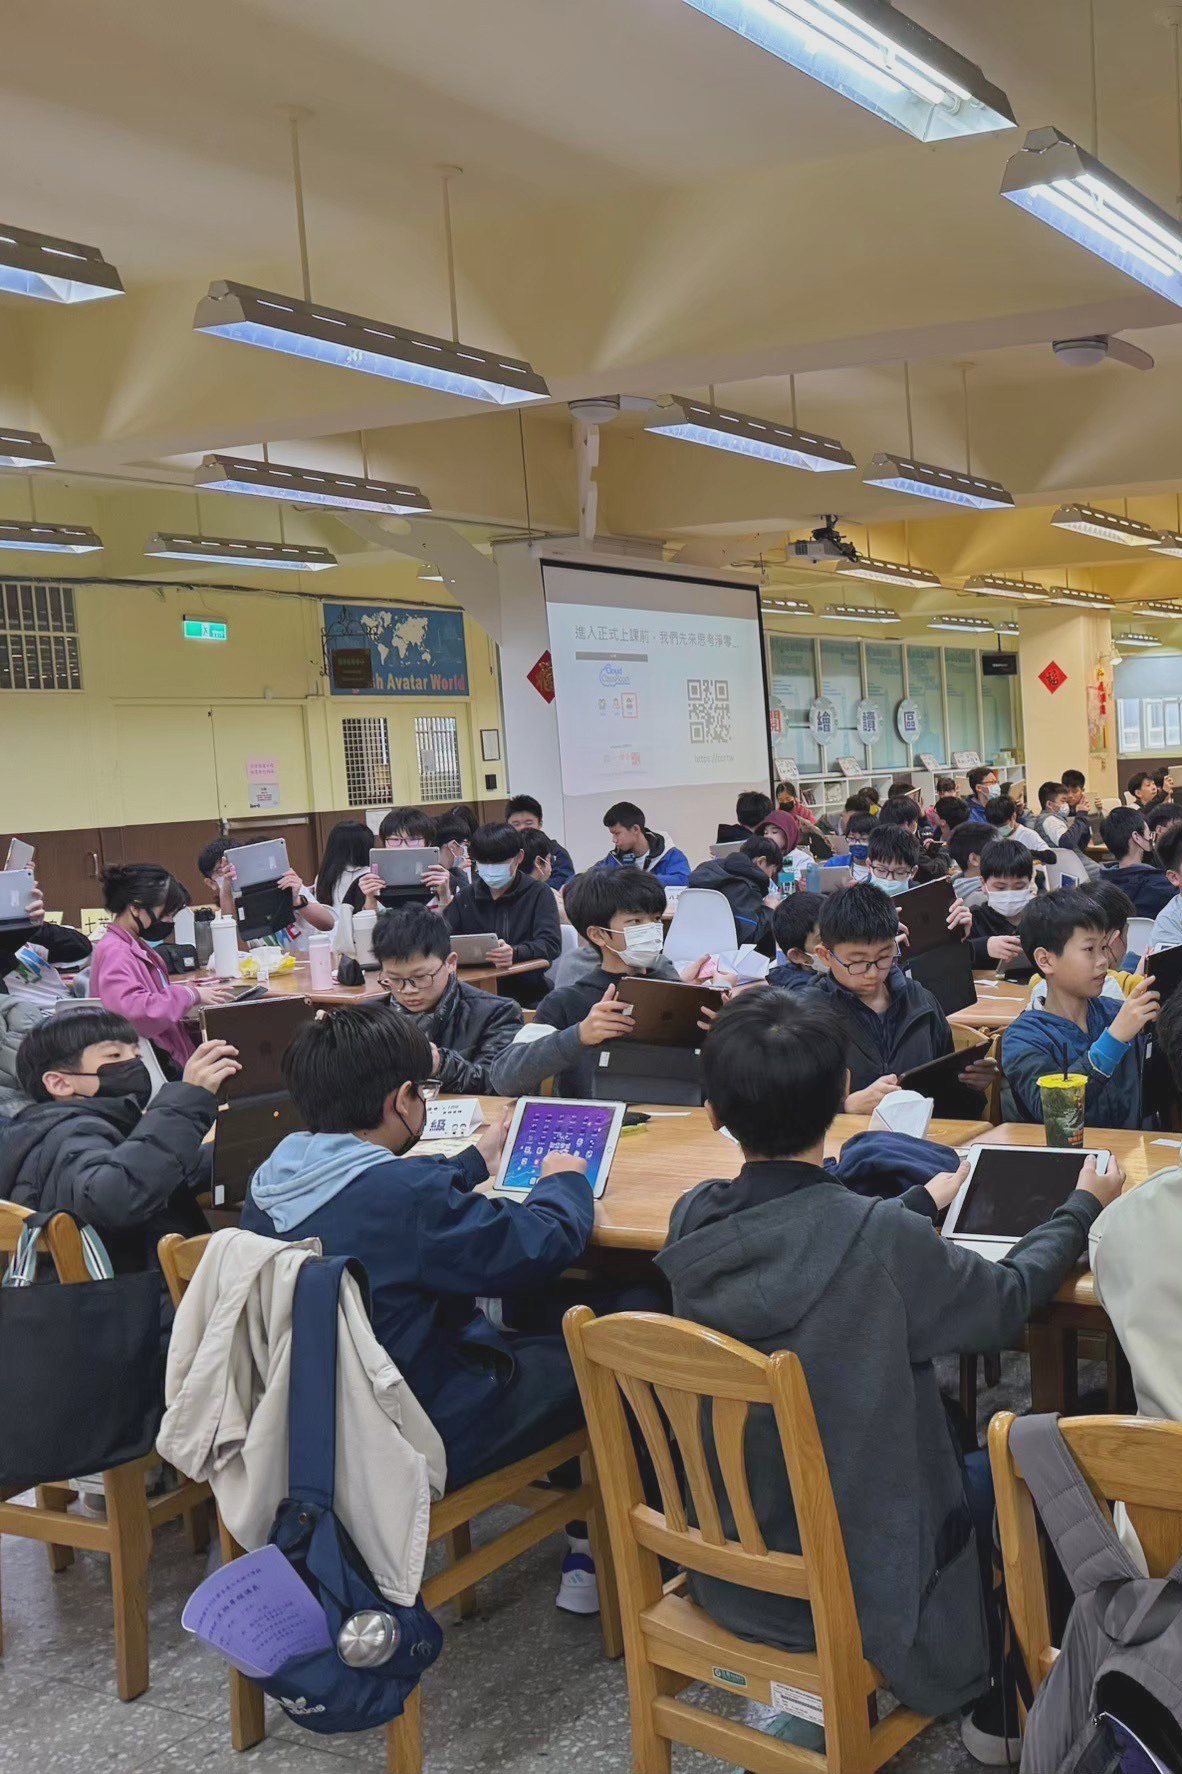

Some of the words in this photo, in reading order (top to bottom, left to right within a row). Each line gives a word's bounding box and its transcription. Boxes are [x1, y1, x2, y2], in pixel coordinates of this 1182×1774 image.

[387, 673, 428, 691] Avatar
[430, 673, 466, 691] World
[903, 711, 917, 731] 區
